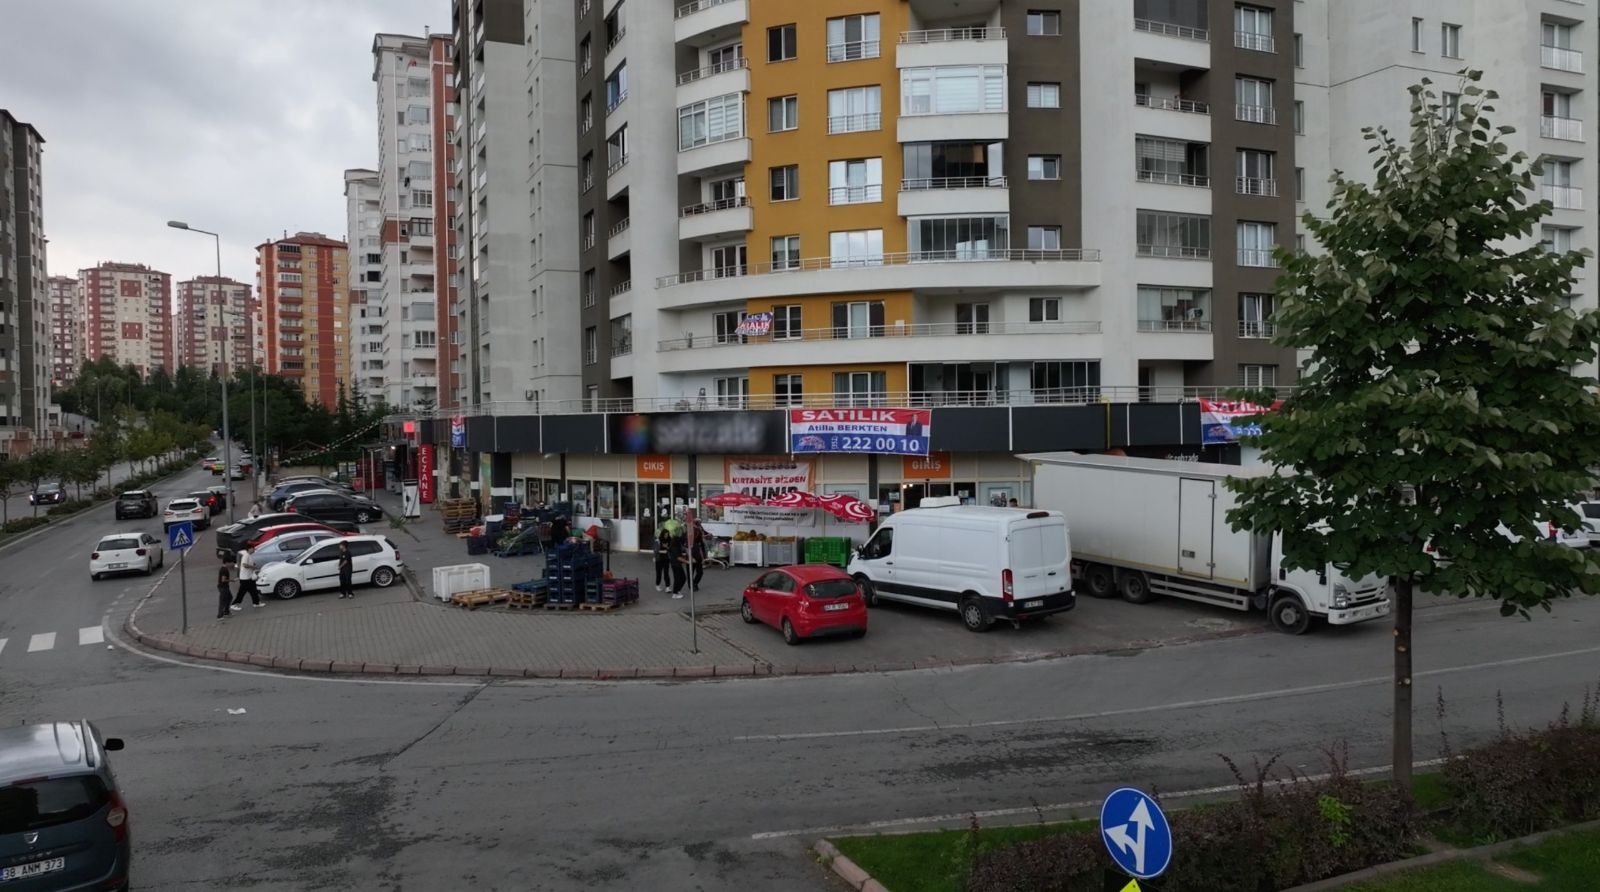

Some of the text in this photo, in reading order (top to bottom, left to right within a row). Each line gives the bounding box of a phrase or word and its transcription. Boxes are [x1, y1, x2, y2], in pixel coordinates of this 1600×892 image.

[801, 410, 897, 421] SATILIK
[808, 424, 888, 432] Atilla BERKTEN
[842, 437, 920, 451] 222 00 10
[643, 461, 665, 472] ÇIKIŞ
[421, 447, 429, 499] ECZANE
[3, 868, 16, 879] 38
[44, 858, 63, 870] 373
